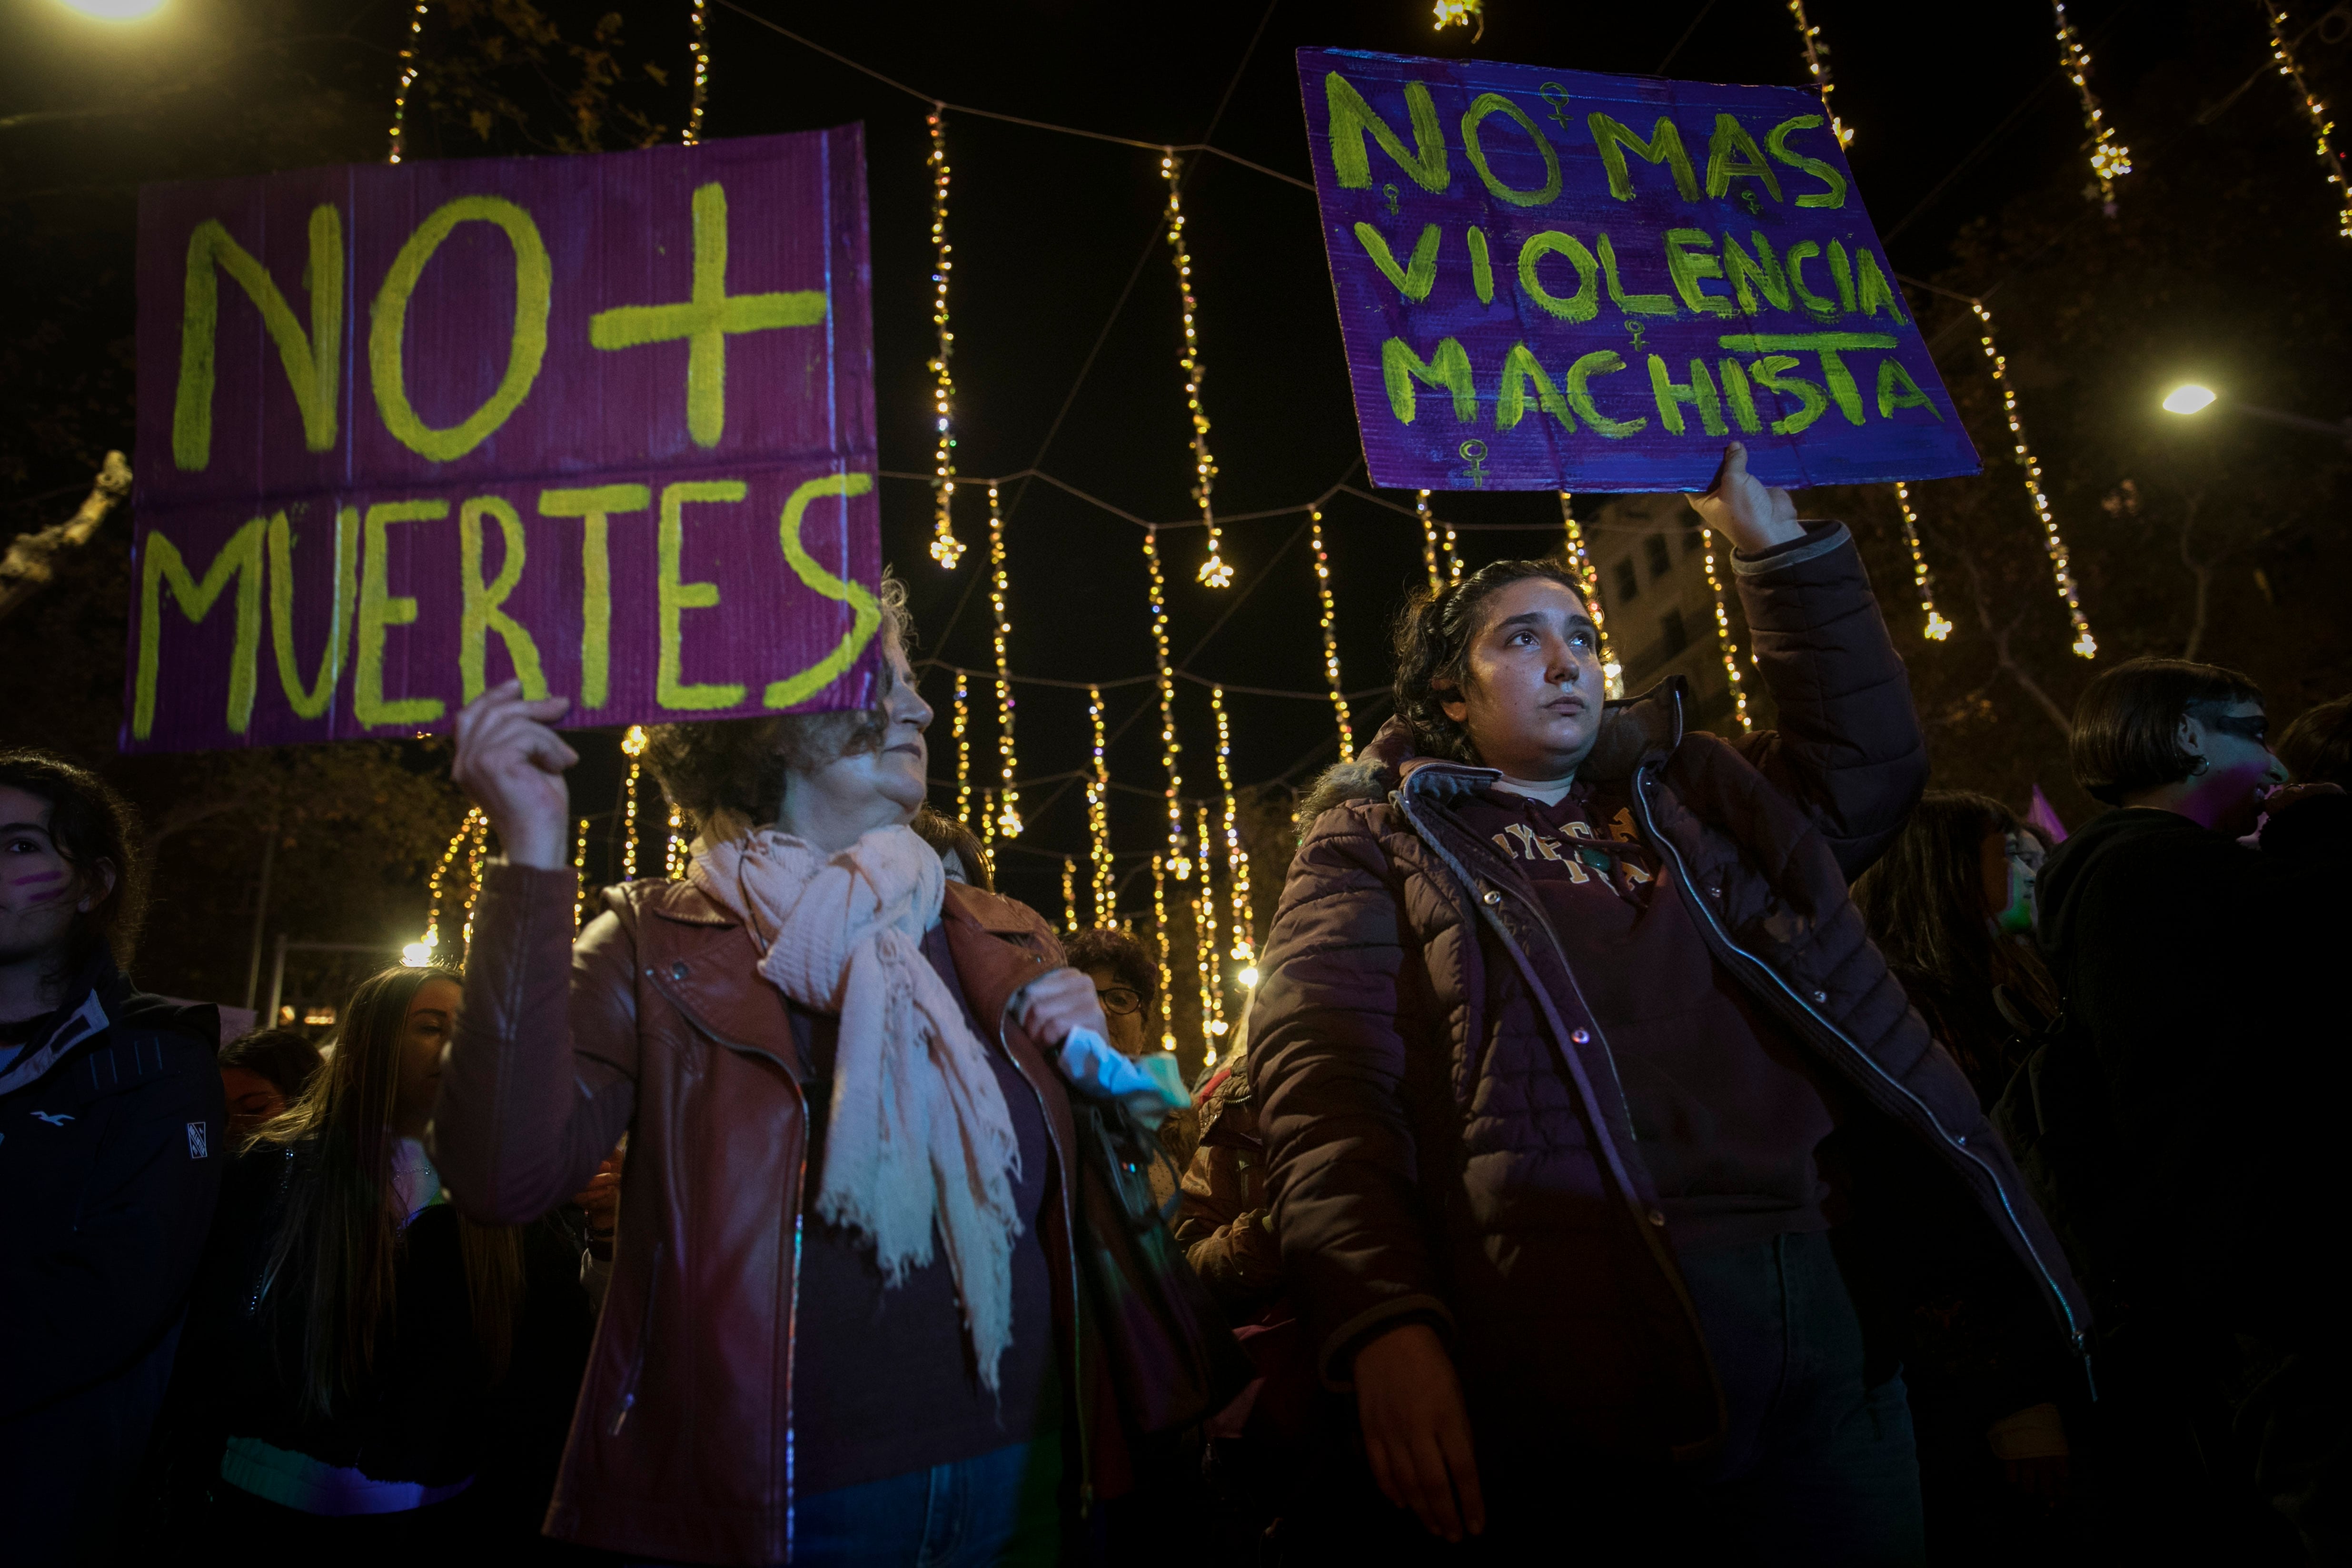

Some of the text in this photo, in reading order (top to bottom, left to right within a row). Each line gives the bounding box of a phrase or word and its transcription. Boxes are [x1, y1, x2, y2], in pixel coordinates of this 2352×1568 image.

[1326, 71, 1846, 208] NO MAS
[1354, 222, 1907, 326] VIOLENCIA
[1381, 331, 1945, 439] MACHISTA
[134, 473, 882, 740] MUERTES
